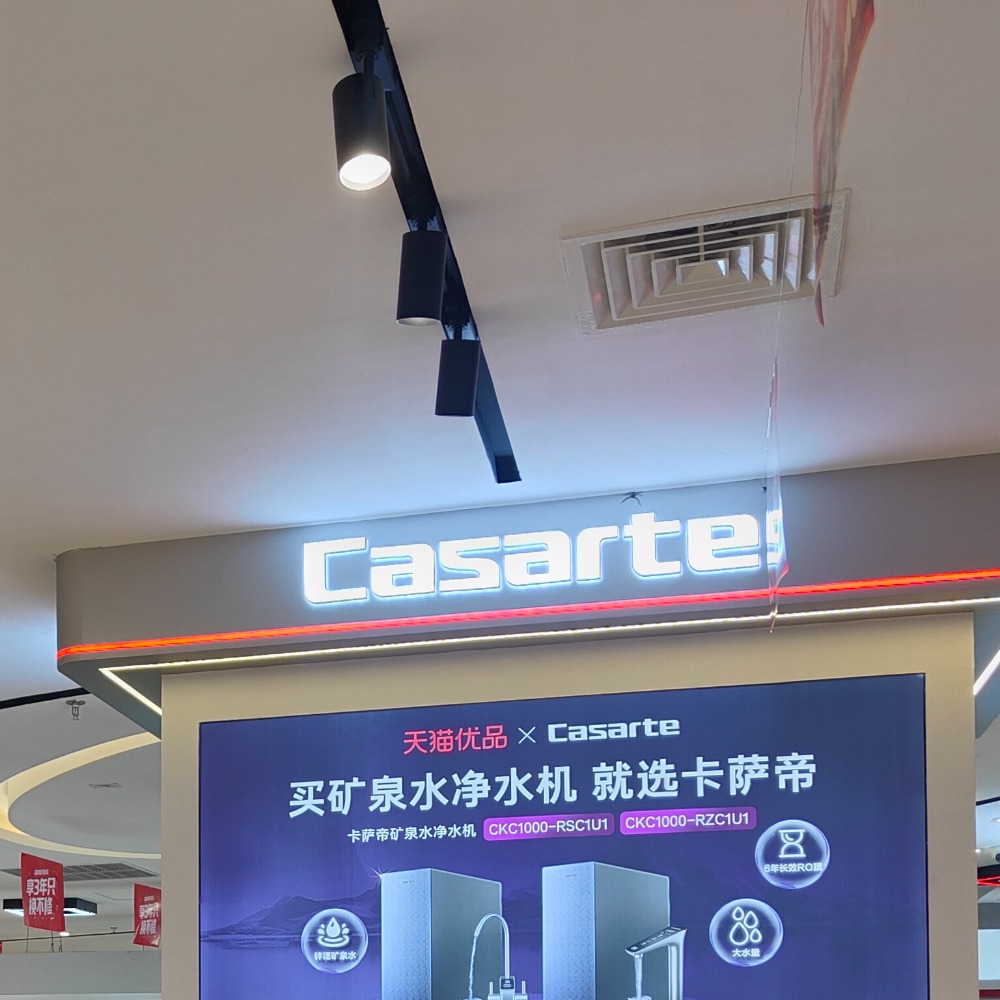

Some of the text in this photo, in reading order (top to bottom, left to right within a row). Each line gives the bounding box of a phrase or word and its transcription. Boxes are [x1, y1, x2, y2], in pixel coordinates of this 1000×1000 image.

[302, 512, 759, 605] Casarte
[403, 724, 508, 755] 天猫优品
[547, 718, 681, 742] Casarte
[288, 752, 817, 818] 买矿泉水净水机 就选卡萨帝
[347, 812, 750, 843] 卡萨帝矿泉水净水机 CKC1000-RSC1U1 CKC1000-RZC1U1
[26, 877, 56, 897] 享3年只
[28, 896, 53, 916] 换不修
[731, 948, 761, 958] 大水量
